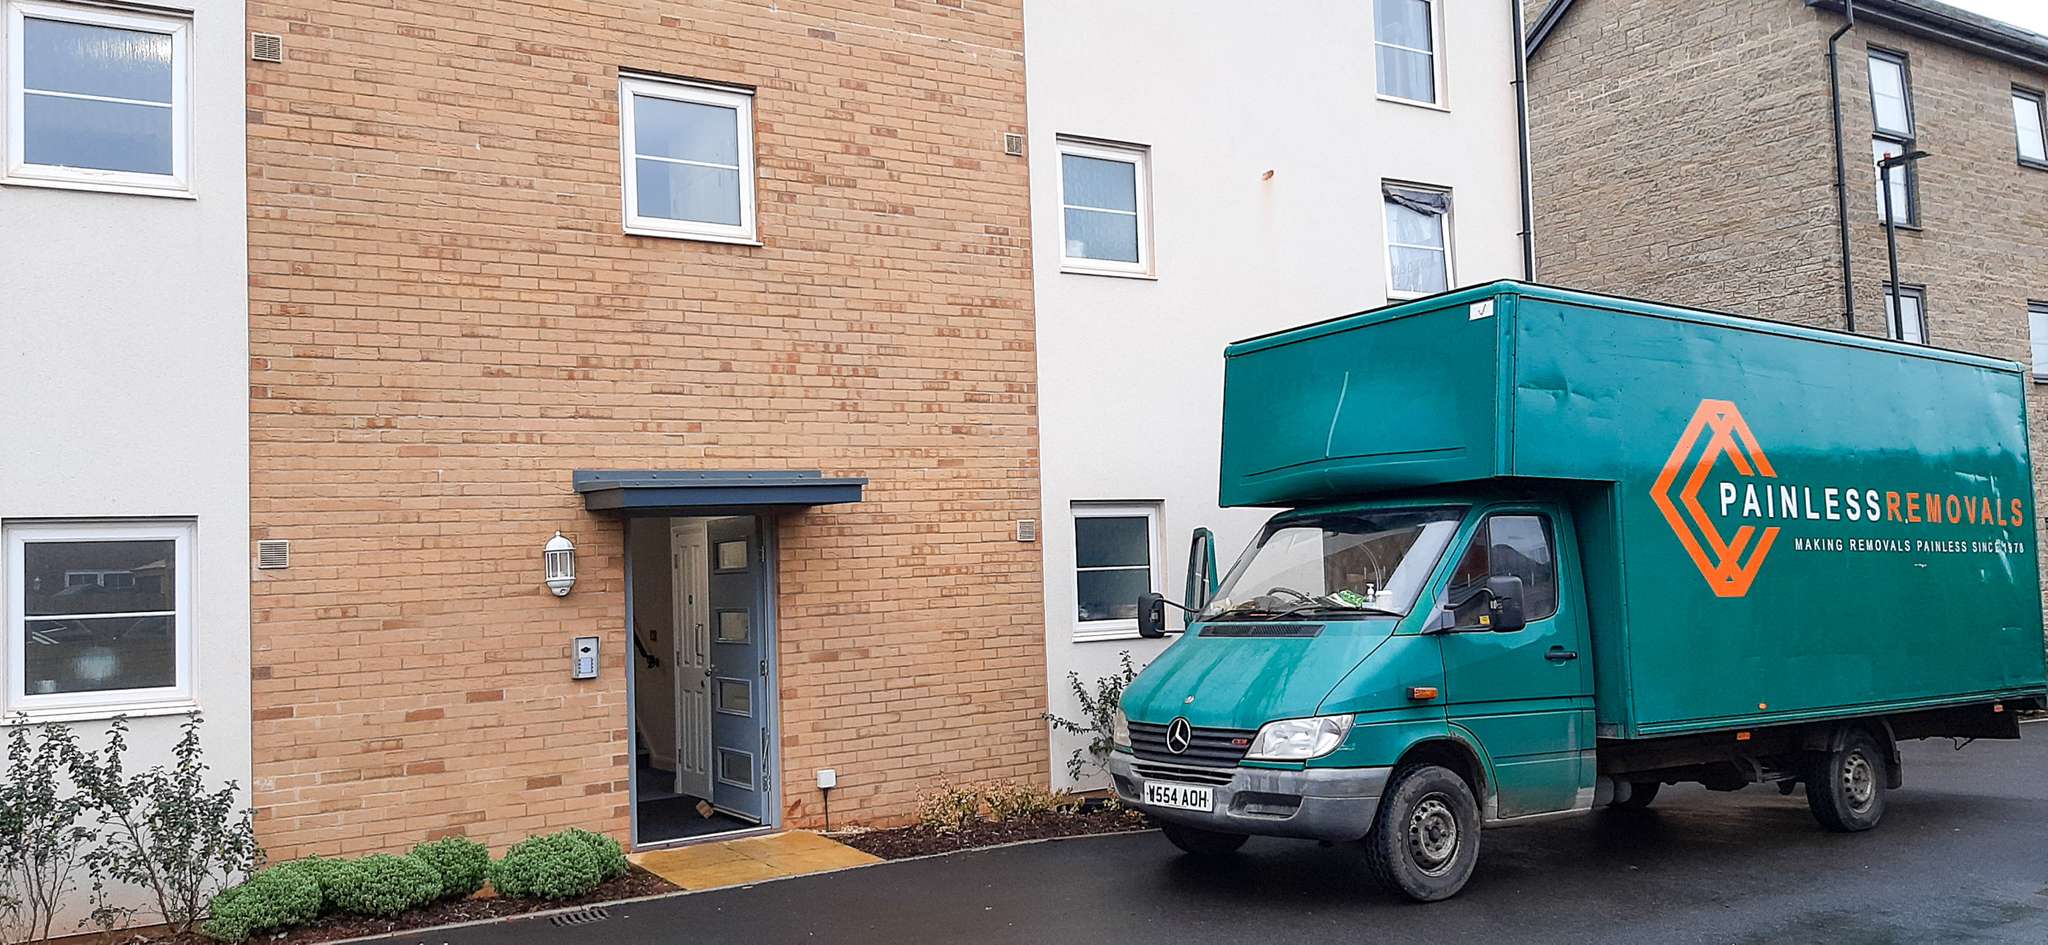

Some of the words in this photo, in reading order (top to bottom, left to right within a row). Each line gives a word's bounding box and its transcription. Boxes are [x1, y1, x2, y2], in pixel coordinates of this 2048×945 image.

[1795, 538, 1843, 551] MAKING
[1849, 539, 1911, 552] REMOVALS
[1916, 540, 1967, 553] PAINLESS
[1972, 540, 2000, 553] SINCE
[1148, 785, 1178, 805] W554
[1181, 788, 1207, 808] AOH
